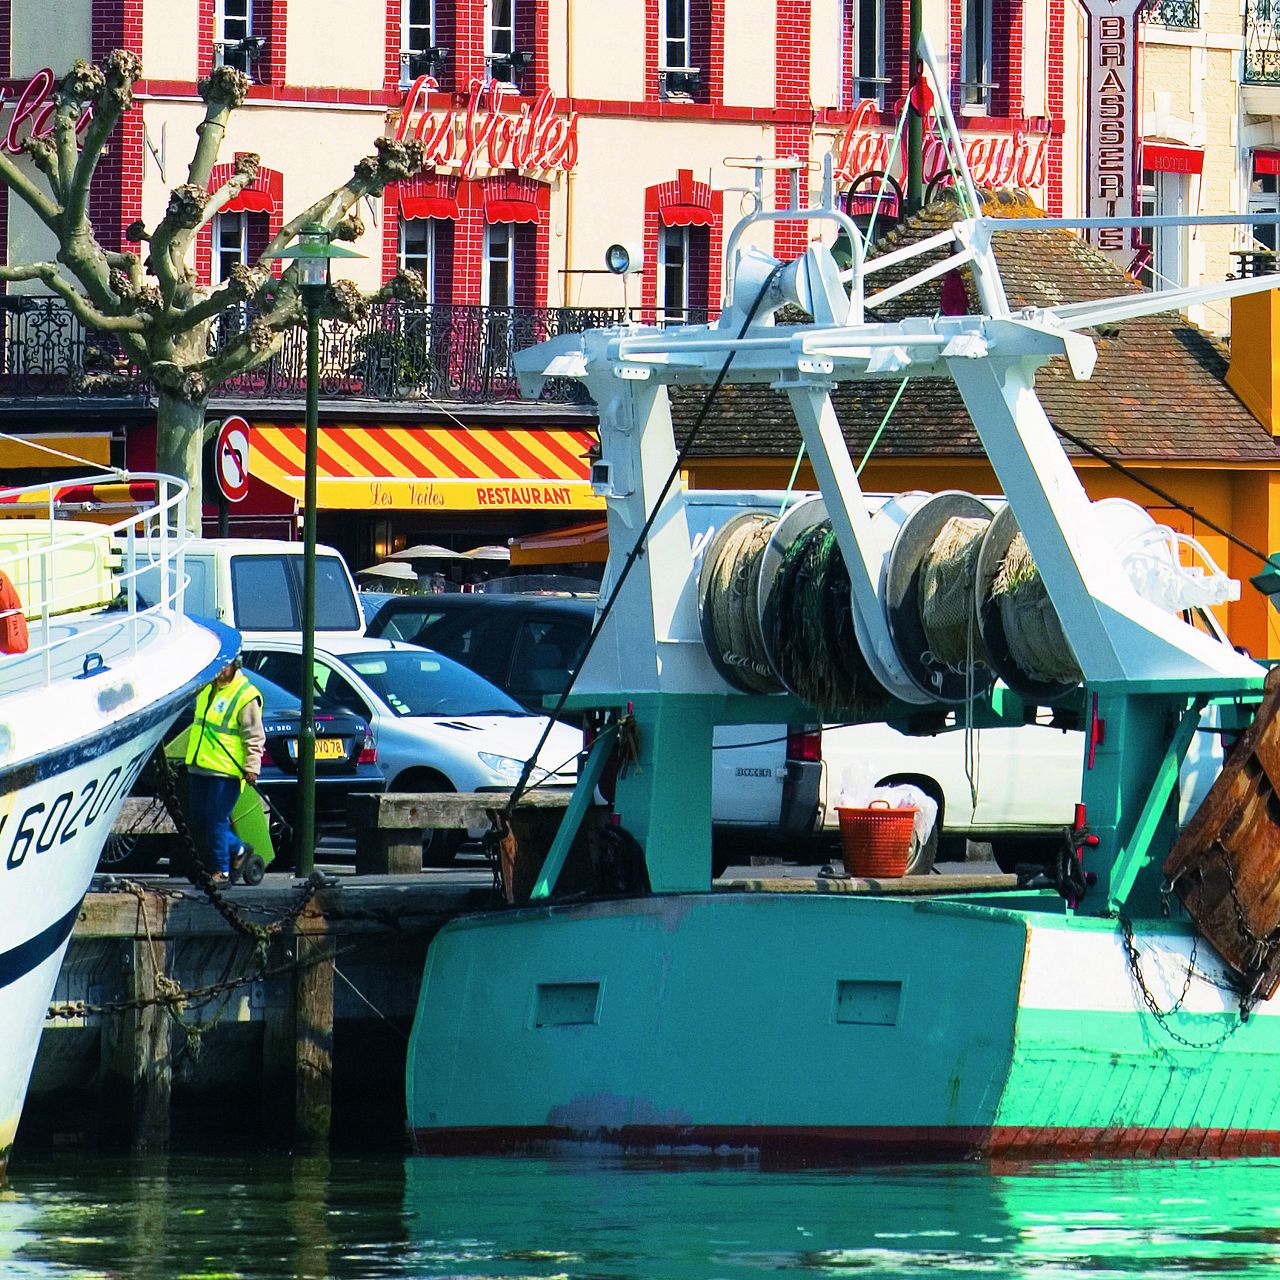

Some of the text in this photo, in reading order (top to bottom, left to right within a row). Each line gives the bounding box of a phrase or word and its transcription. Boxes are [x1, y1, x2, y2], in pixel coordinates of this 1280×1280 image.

[1097, 15, 1126, 251] BRASSERIE
[369, 481, 573, 506] Les Voiles RESTAURANT
